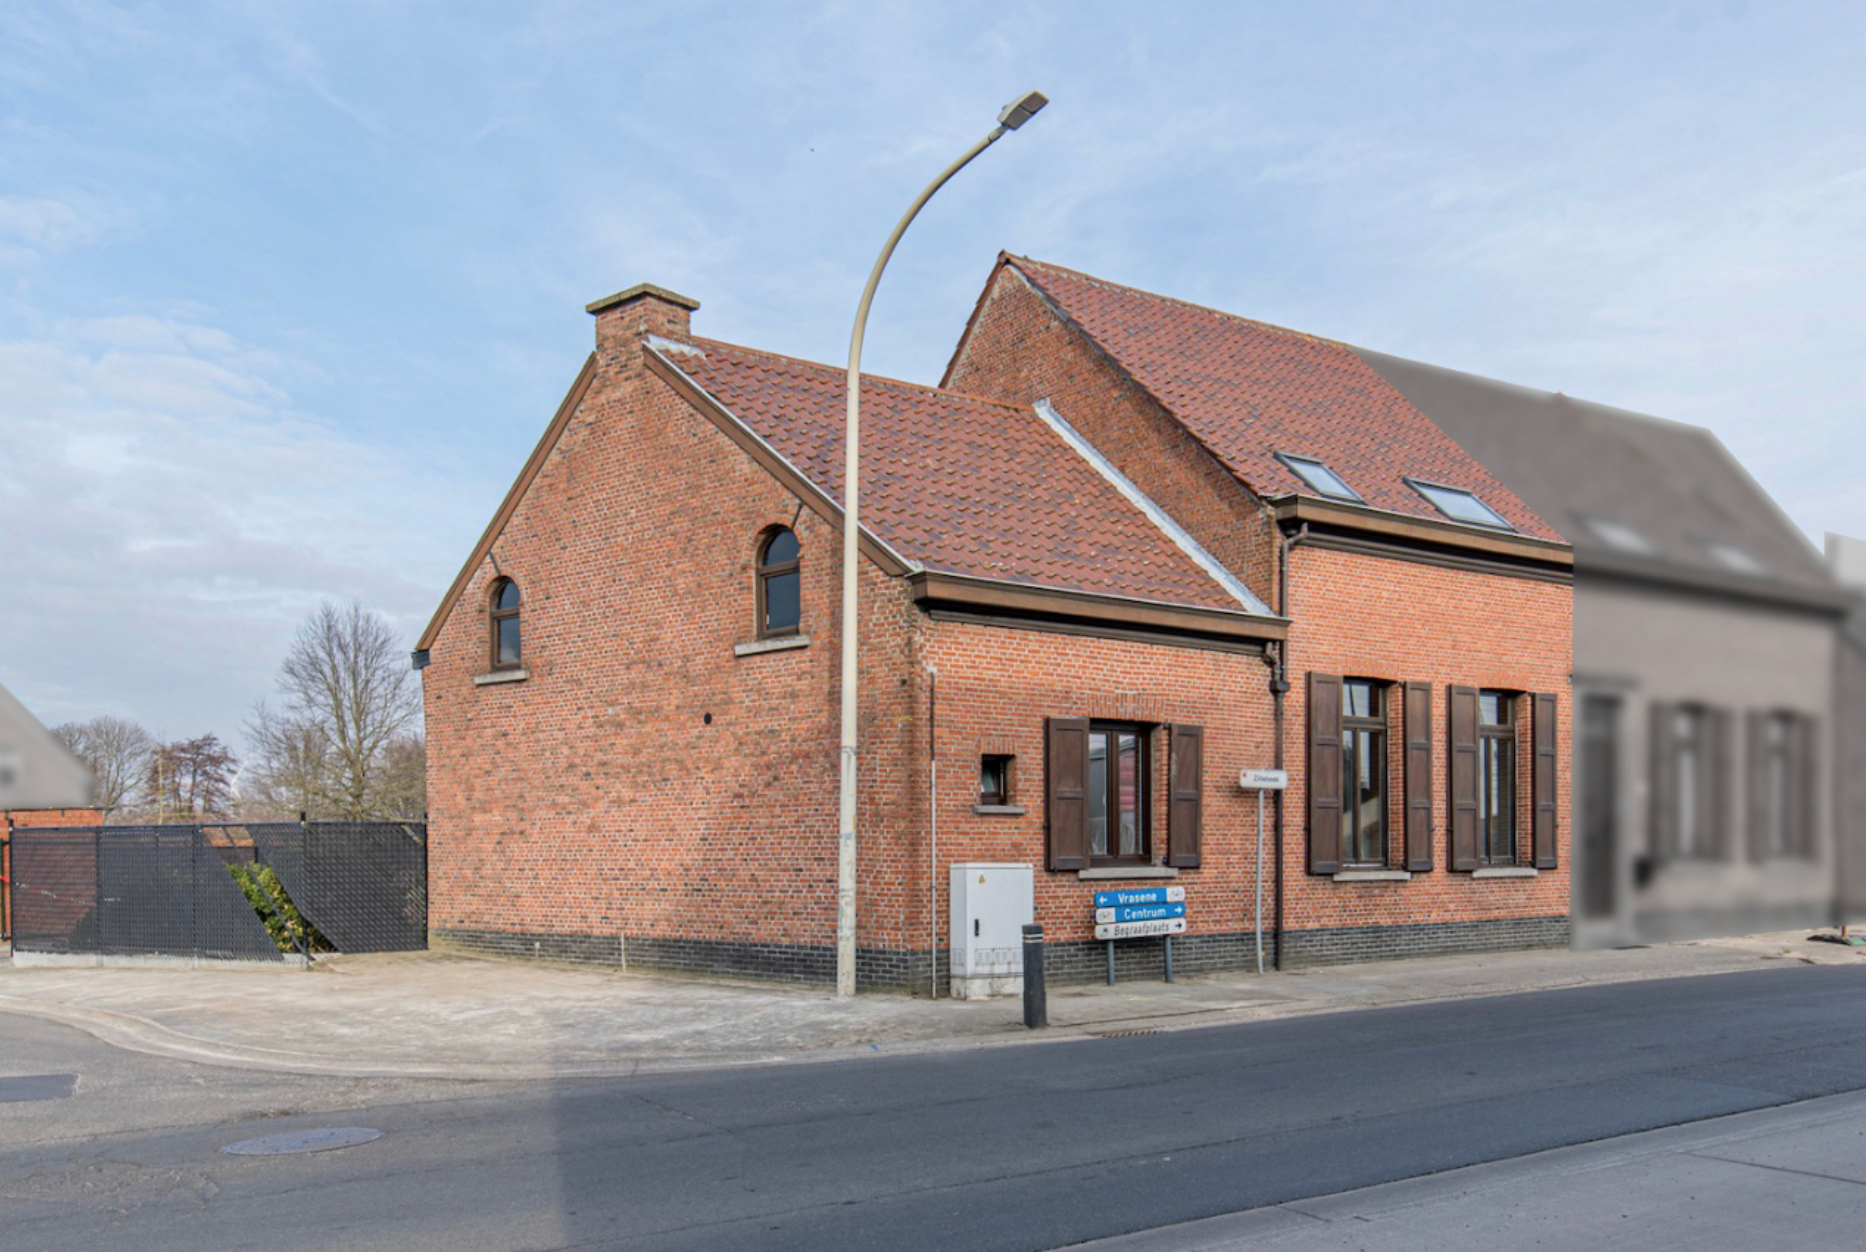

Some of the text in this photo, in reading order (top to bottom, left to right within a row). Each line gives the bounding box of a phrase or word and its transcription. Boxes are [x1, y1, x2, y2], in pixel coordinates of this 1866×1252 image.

[1117, 892, 1157, 904] Vrasene
[1124, 908, 1166, 919] Centrum
[1114, 923, 1169, 936] Begraafplaats
